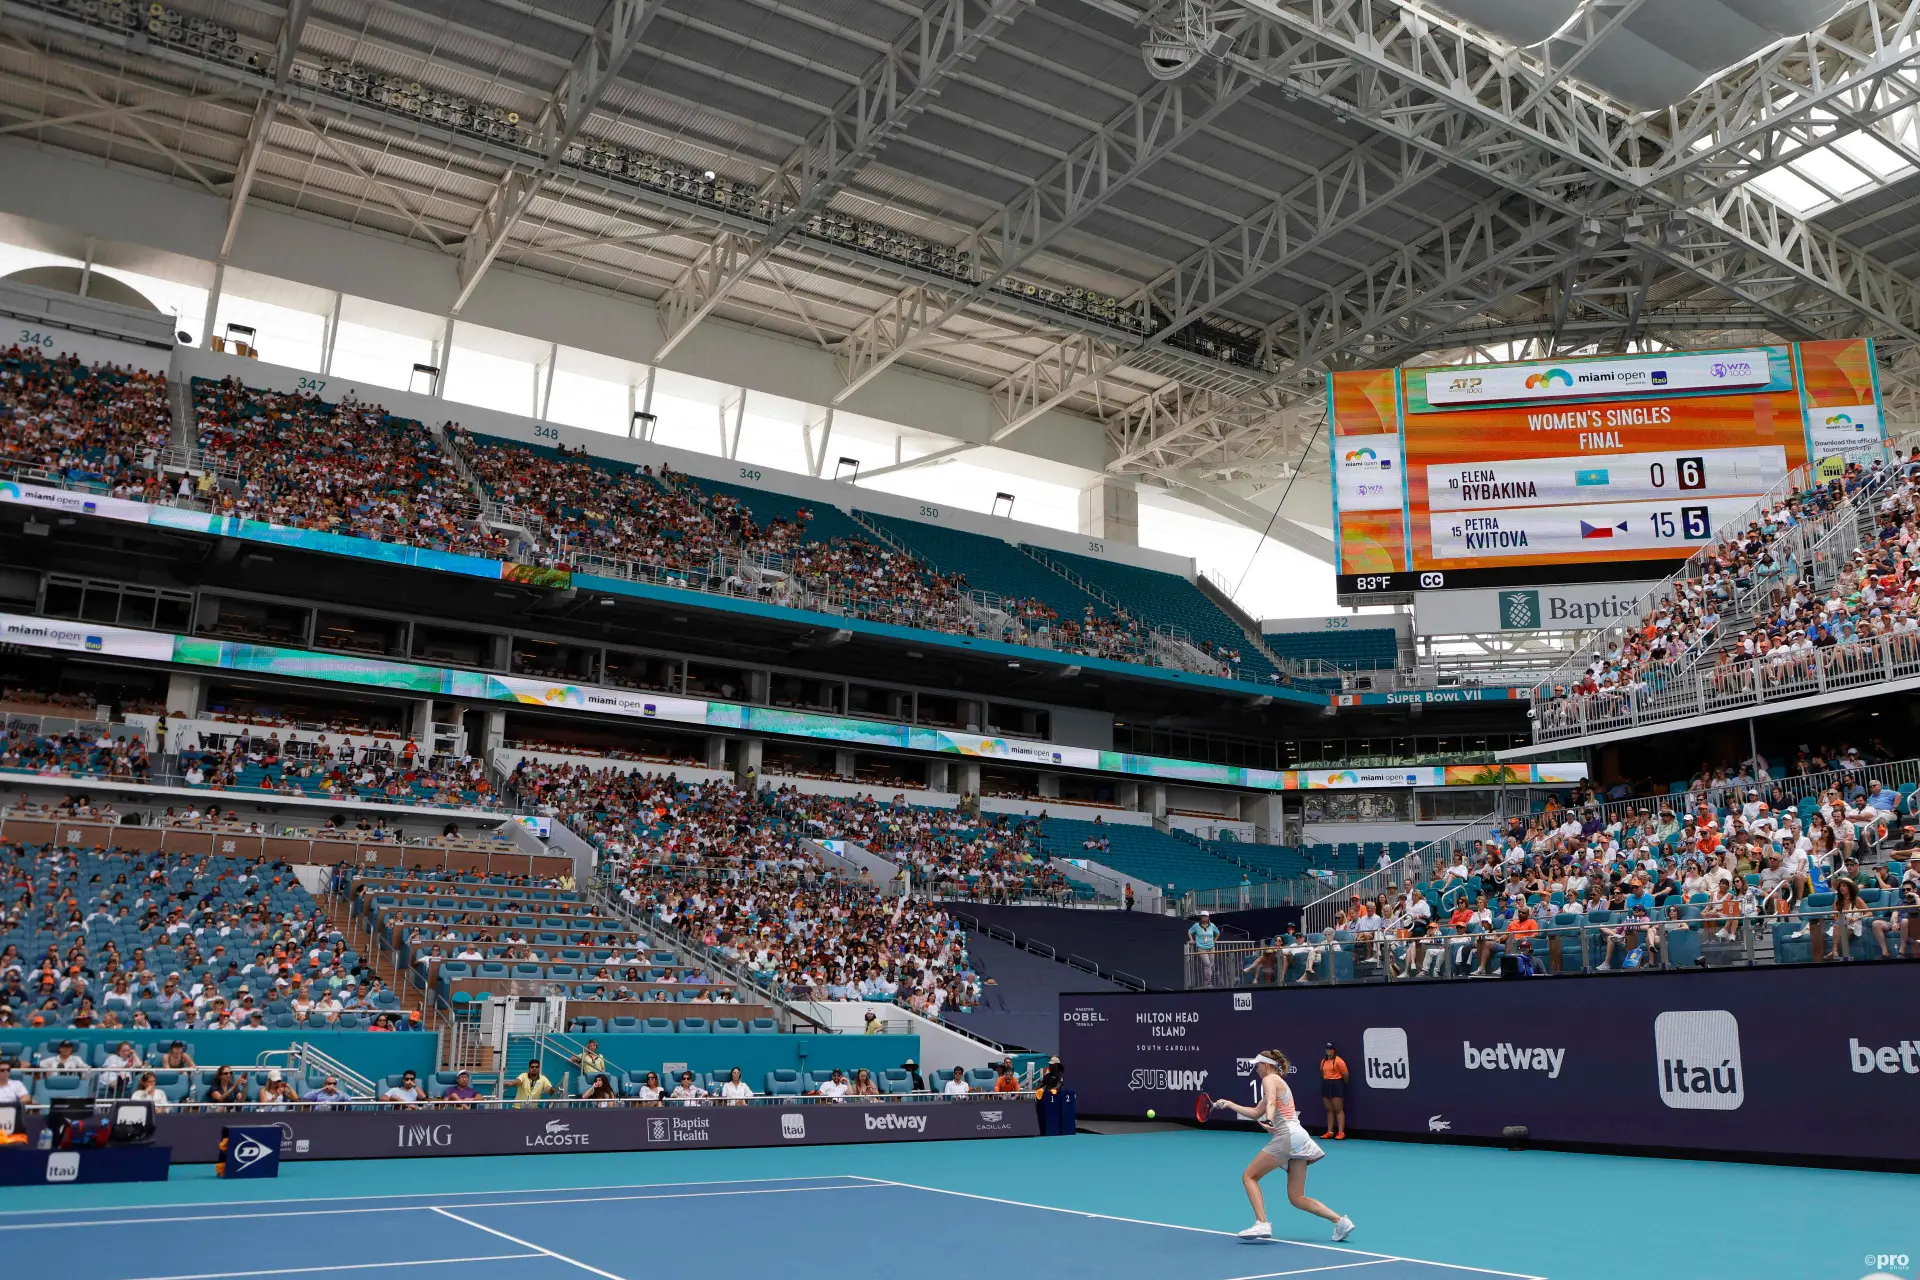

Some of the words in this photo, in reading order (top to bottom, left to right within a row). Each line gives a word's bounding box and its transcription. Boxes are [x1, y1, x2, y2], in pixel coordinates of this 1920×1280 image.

[19, 330, 53, 347] 346
[1449, 377, 1483, 390] ATP
[1578, 371, 1615, 383] miami
[1617, 370, 1646, 382] open
[297, 376, 326, 392] 347
[1527, 408, 1602, 431] WOMEN'S
[1607, 406, 1672, 427] SINGLES
[533, 425, 559, 441] 348
[1579, 431, 1624, 450] FINAL
[1814, 439, 1846, 447] Download
[738, 467, 762, 482] 349
[1461, 469, 1496, 483] ELENA
[1650, 462, 1665, 488] 0
[1682, 460, 1699, 487] 6
[1448, 478, 1459, 489] 10
[1462, 481, 1537, 501] RYBAKINA
[25, 490, 55, 502] miami
[56, 496, 81, 507] open
[919, 505, 939, 519] 350
[1465, 517, 1499, 531] PETRA
[1650, 512, 1676, 538] 15
[1688, 510, 1705, 537] 5
[1451, 526, 1462, 538] 15
[1466, 530, 1529, 550] KVITOVA
[1088, 541, 1105, 554] 351
[1356, 576, 1391, 590] 83°F
[1422, 574, 1442, 587] CC
[1548, 595, 1640, 625] Baptist
[1325, 617, 1349, 629] 352
[8, 624, 48, 637] miami
[50, 630, 81, 641] open
[588, 695, 617, 706] miami
[618, 699, 641, 709] open
[1463, 690, 1482, 701] VII
[177, 723, 193, 731] 247
[497, 752, 510, 760] 248
[1011, 746, 1033, 755] miami
[1033, 750, 1050, 758] open
[1360, 774, 1384, 782] miami
[1385, 774, 1404, 782] open
[1235, 997, 1251, 1008] Itaú
[1136, 1012, 1172, 1023] HILTON
[1175, 1011, 1199, 1023] HEAD
[1152, 1026, 1186, 1037] ISLAND
[1136, 1044, 1161, 1052] SOUTH
[1165, 1044, 1200, 1052] CAROLINA
[1463, 1040, 1566, 1079] betway
[1849, 1037, 1920, 1074] bet
[1237, 1061, 1253, 1073] SAP
[1367, 1057, 1407, 1079] Itaú
[1128, 1069, 1209, 1091] SUBWAY
[1663, 1059, 1738, 1094] Itaú
[1065, 1094, 1071, 1103] 2
[672, 1117, 710, 1130] Baptist
[864, 1112, 928, 1133] betway
[397, 1124, 453, 1147] IMG
[673, 1130, 709, 1142] Health
[783, 1125, 804, 1135] Itaú
[525, 1134, 590, 1147] LACOSTE
[49, 1165, 77, 1177] Itaú
